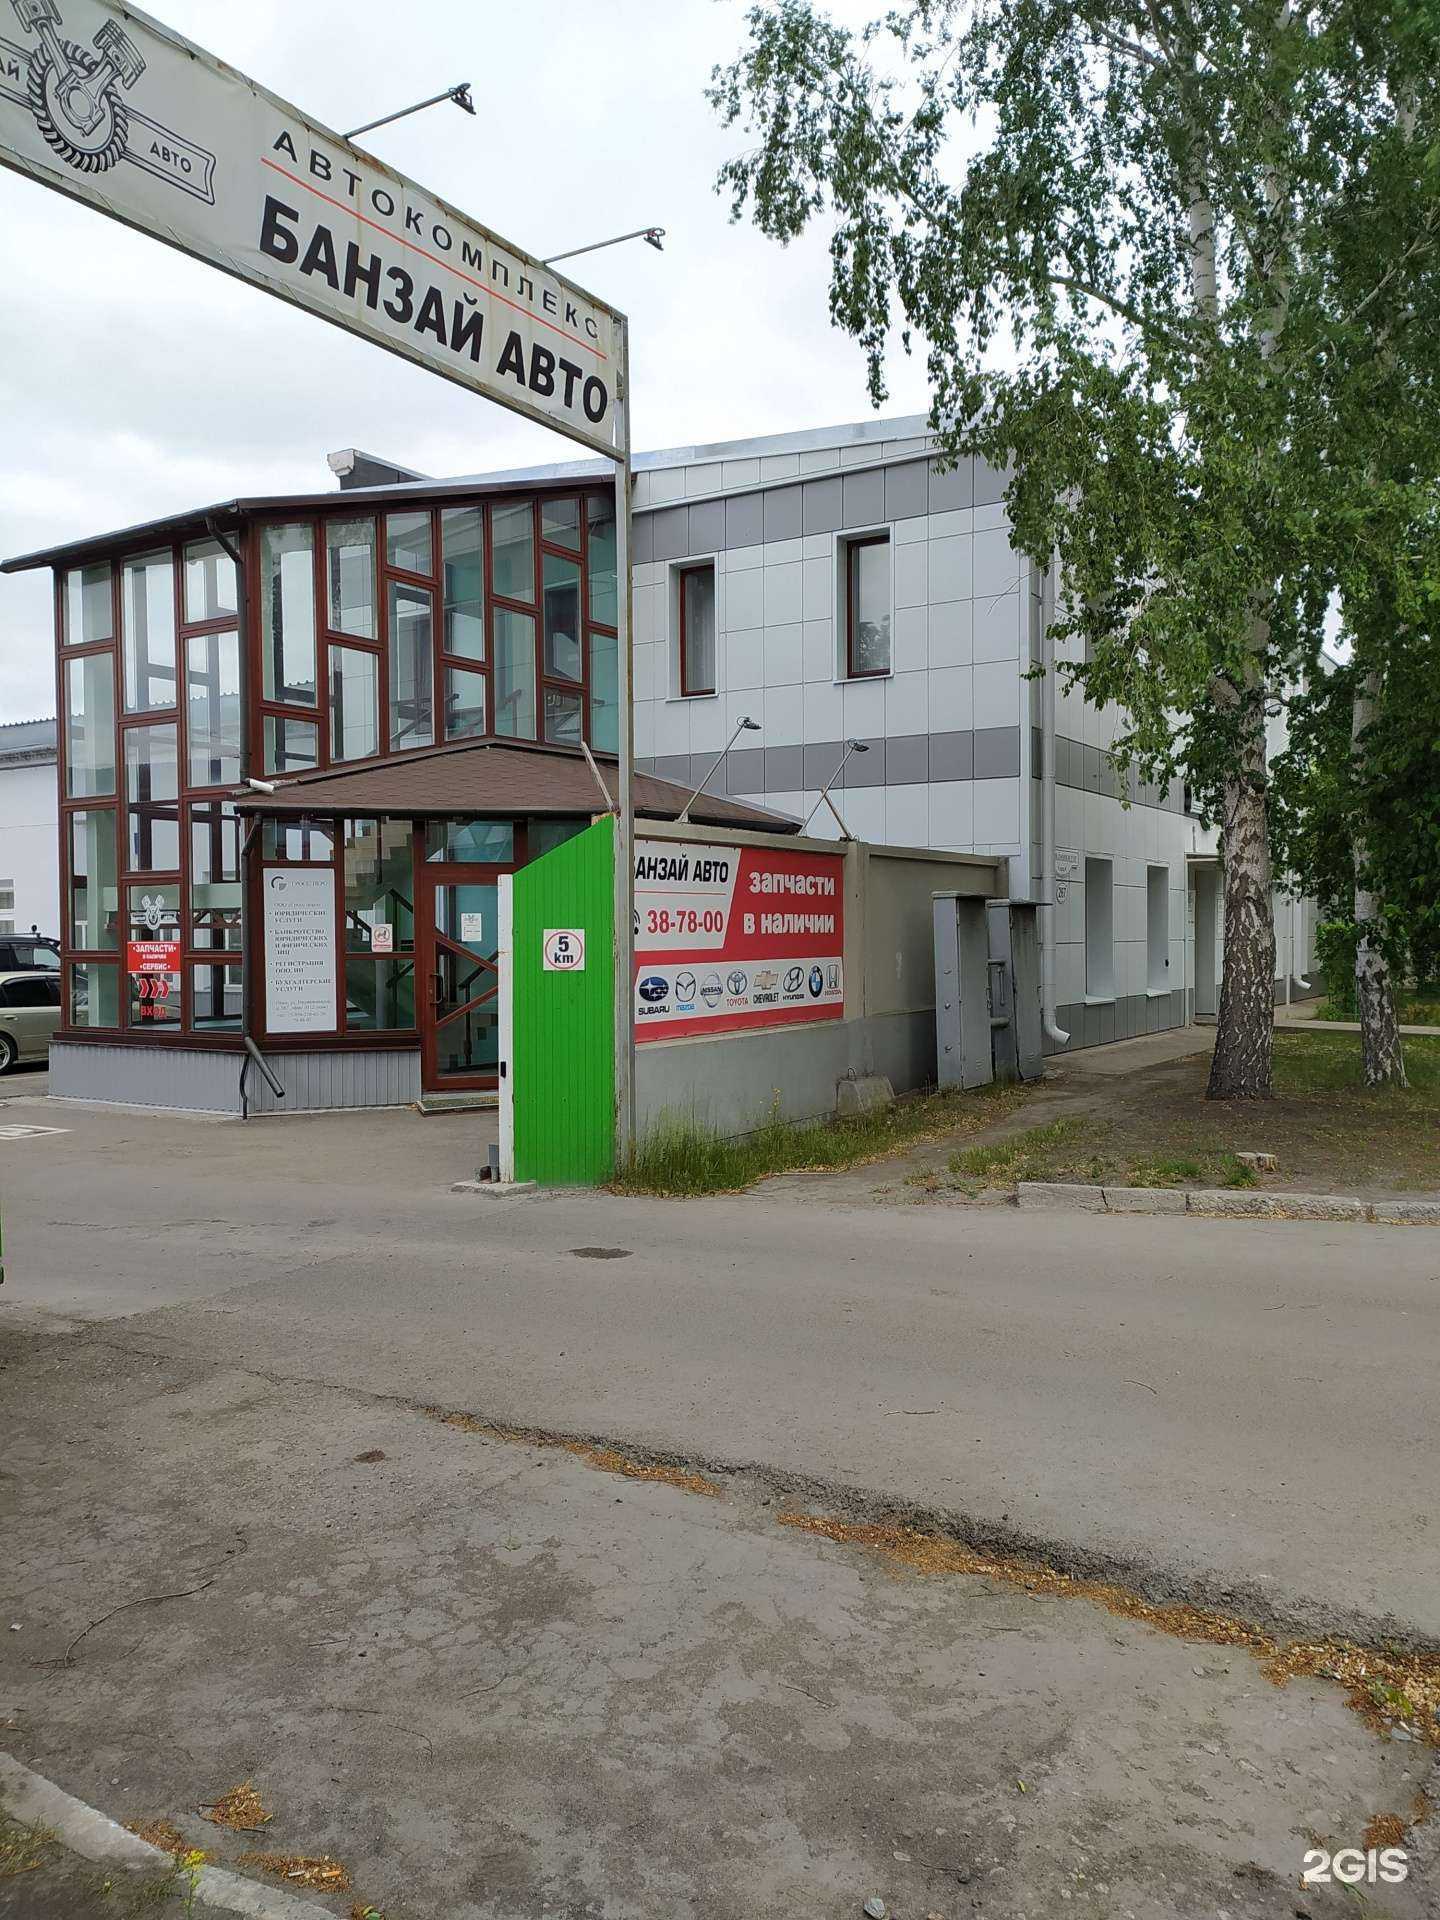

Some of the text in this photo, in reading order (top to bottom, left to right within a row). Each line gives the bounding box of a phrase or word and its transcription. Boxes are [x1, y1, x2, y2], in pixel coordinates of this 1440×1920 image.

[149, 140, 193, 174] АВТО
[272, 129, 600, 340] АВТОКОМПЛЕКС
[258, 194, 609, 424] БАНЗАЙ АВТО
[633, 852, 729, 883] АНЗАЙ АВТО
[647, 909, 724, 934] 38-78-00
[760, 912, 835, 935] наличии
[135, 944, 174, 953] ЗАПЧАСТИ
[558, 935, 569, 952] 5
[554, 952, 574, 964] km
[142, 963, 168, 971] СЕРВИС
[726, 997, 749, 1007] TOYOTA
[752, 992, 780, 1004] CHEVROLET
[638, 1005, 670, 1016] SUBARU
